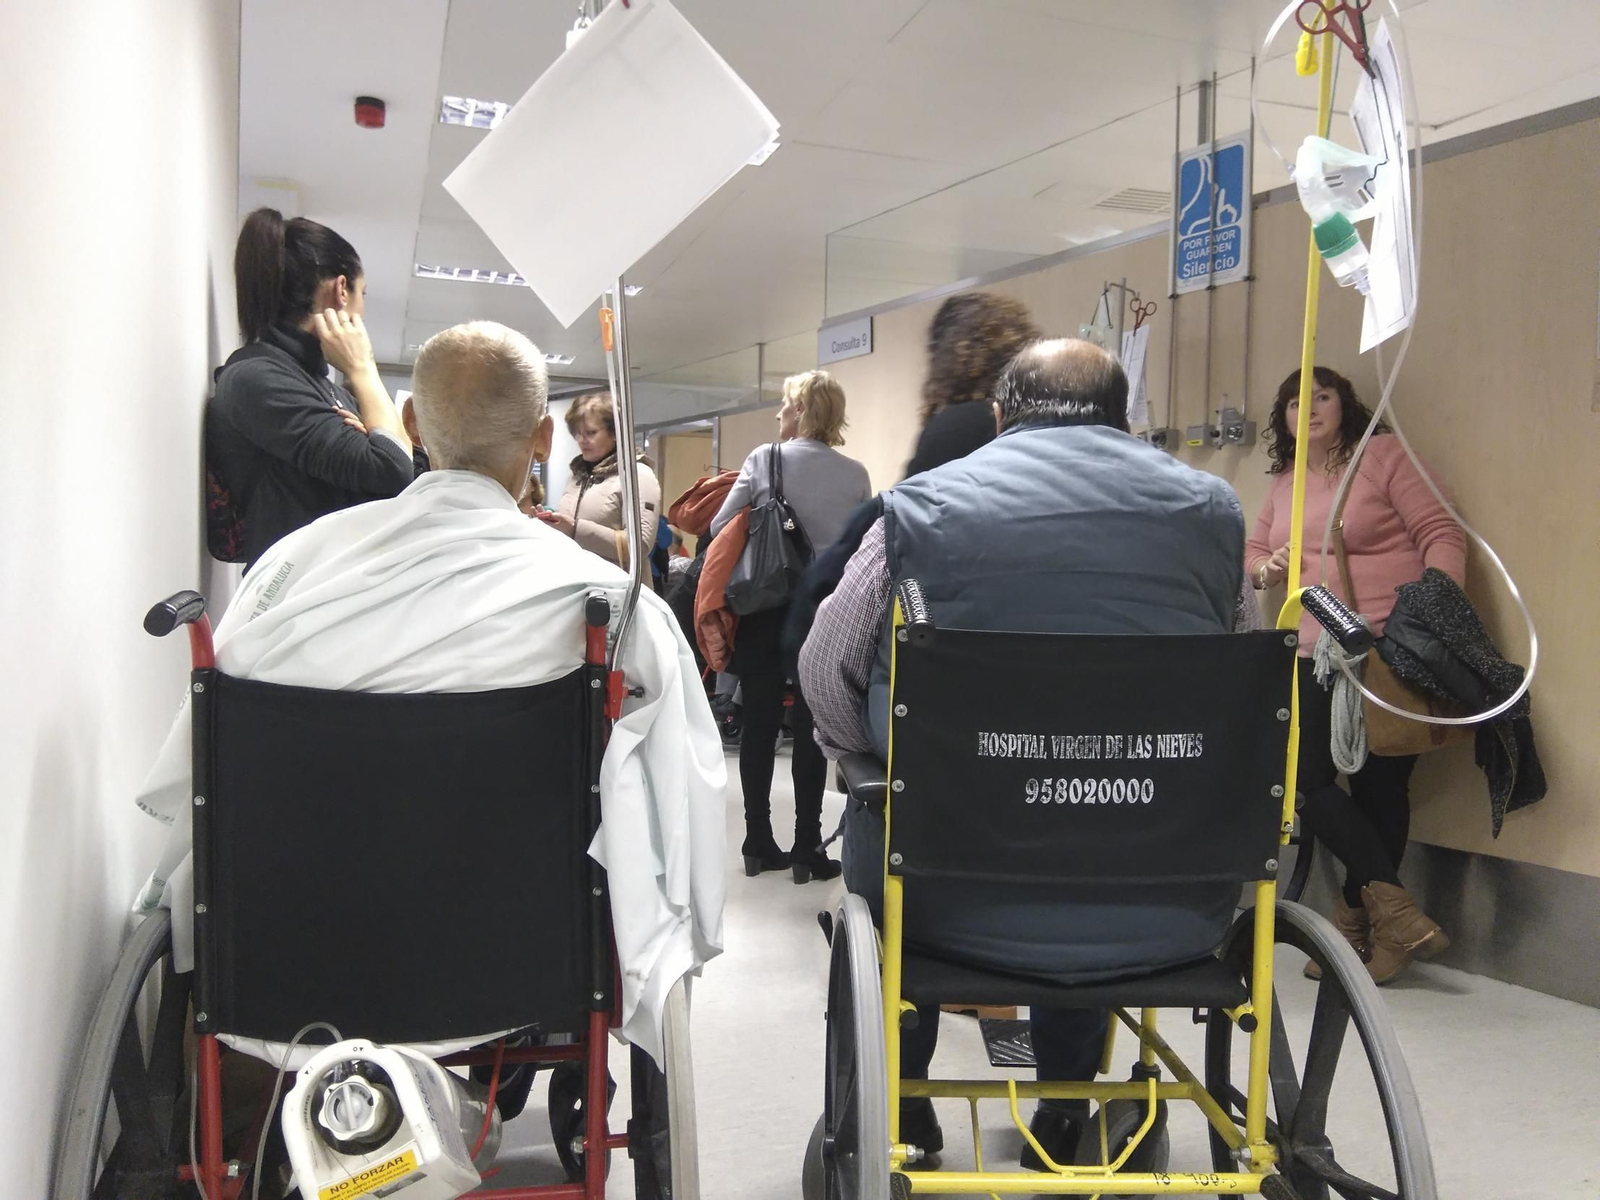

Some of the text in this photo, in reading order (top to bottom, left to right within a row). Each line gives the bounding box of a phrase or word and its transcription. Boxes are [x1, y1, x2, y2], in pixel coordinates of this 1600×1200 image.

[1183, 239, 1203, 250] POR
[832, 333, 867, 354] Consulta 9
[978, 731, 1204, 759] HOSPITAL VIRGEN DE LAS NIEVES
[1025, 778, 1155, 804] 958020000
[330, 1156, 404, 1194] NO FORZAR
